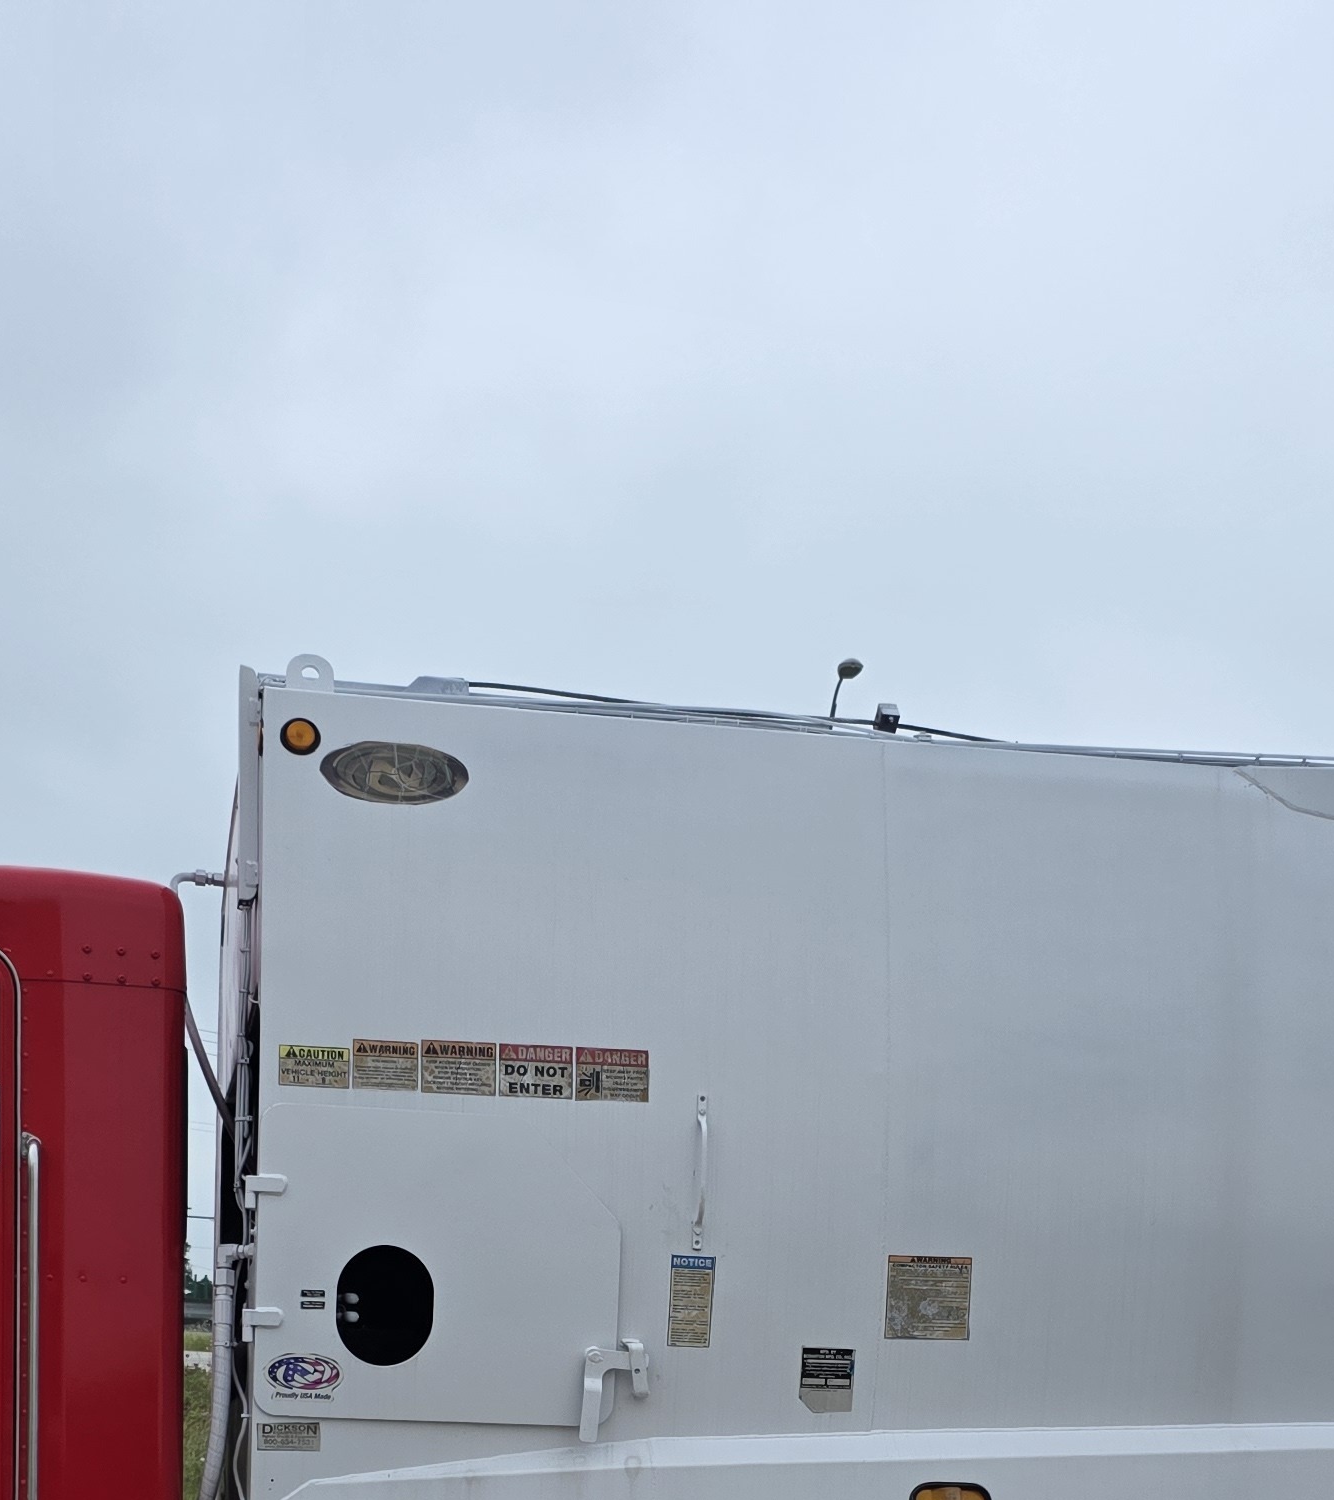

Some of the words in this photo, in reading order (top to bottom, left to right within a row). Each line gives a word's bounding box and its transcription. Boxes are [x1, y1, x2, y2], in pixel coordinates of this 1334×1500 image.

[298, 1048, 344, 1060] CAUTION
[369, 1044, 415, 1056] WARNING
[439, 1044, 493, 1058] WARNING
[518, 1047, 571, 1062] DANGER
[595, 1051, 646, 1065] DANGER
[294, 1060, 335, 1069] MAXIMUM
[281, 1068, 315, 1077] VEHICLE
[317, 1071, 347, 1079] HEIGHT
[504, 1064, 528, 1076] DO
[535, 1065, 568, 1078] NOT
[508, 1082, 563, 1096] ENTER
[673, 1257, 712, 1267] NOTICE
[300, 1392, 312, 1400] USA
[262, 1423, 317, 1435] DICKSON
